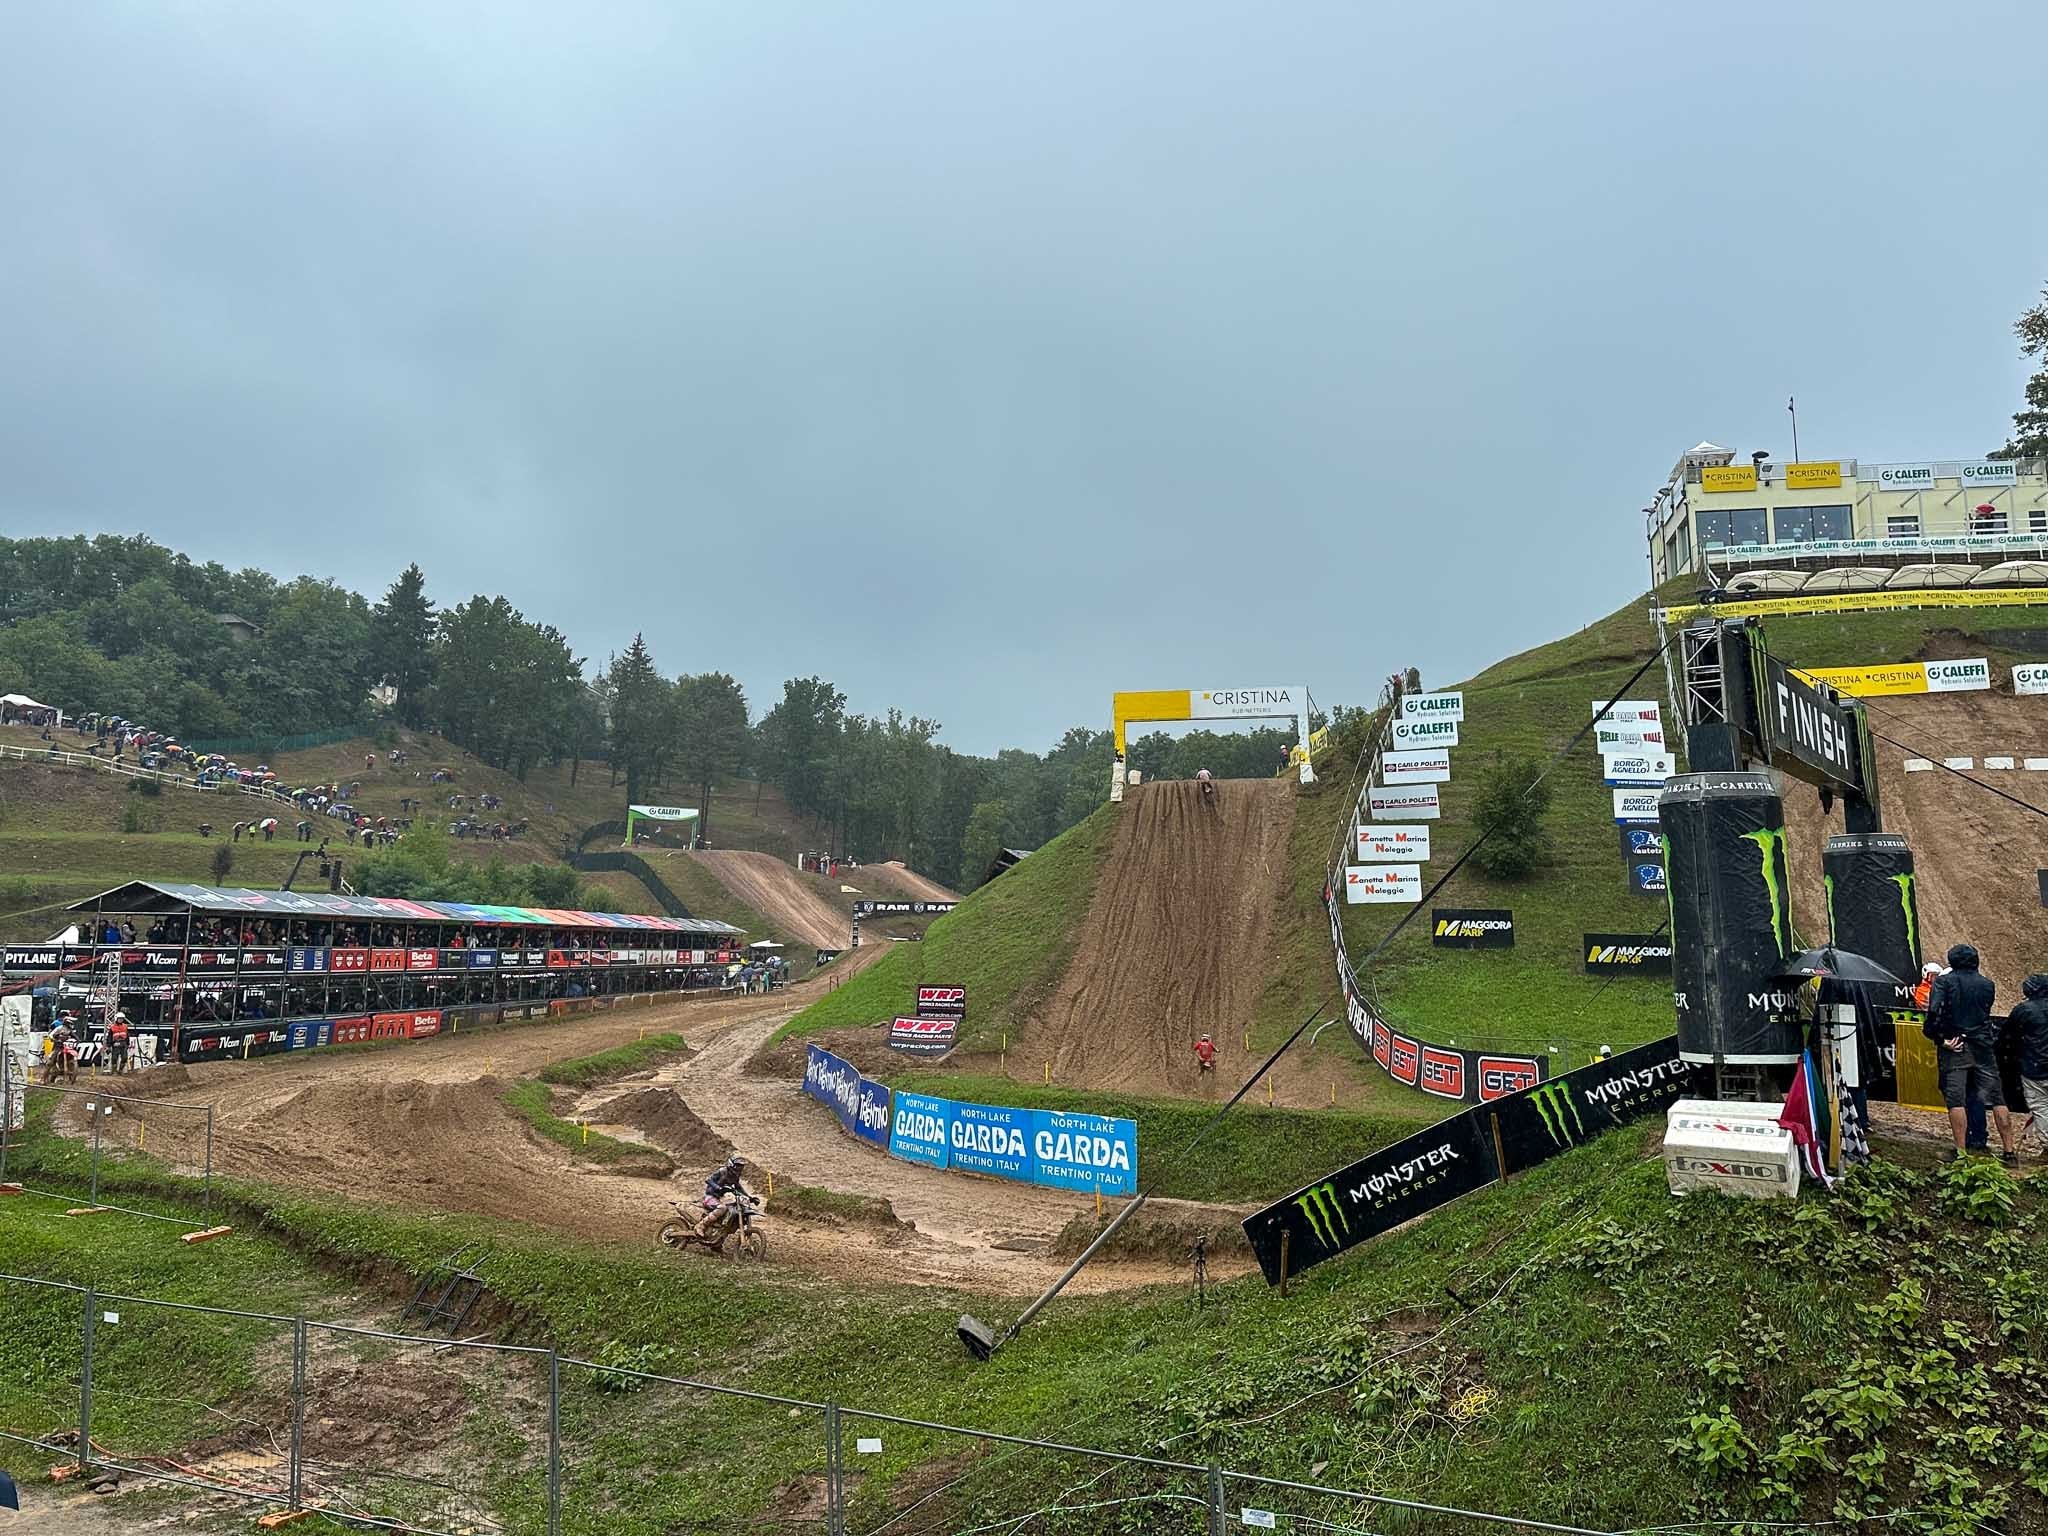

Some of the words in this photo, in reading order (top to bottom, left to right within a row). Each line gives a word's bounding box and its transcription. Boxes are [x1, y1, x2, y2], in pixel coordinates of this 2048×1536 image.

[1795, 469, 1837, 478] CRISTINA
[1895, 469, 1931, 480] CALEFFI
[1977, 465, 2014, 476] CALEFFI
[1710, 474, 1753, 482] CRISTINA
[2007, 535, 2034, 543] CALEFFI
[1872, 671, 1922, 682] CRISTINA
[1943, 664, 1986, 677] CALEFFI
[1213, 690, 1291, 705] CRISTINA
[1420, 698, 1460, 710] CALEFFI
[1638, 709, 1658, 721] VALLE
[1411, 722, 1454, 735] CALEFFI
[1777, 681, 1849, 770] FINISH
[1643, 732, 1662, 743] VALLE
[1408, 796, 1437, 804] POLETTI
[657, 808, 681, 816] CALEFFI
[1621, 804, 1657, 812] AGNELLO
[1359, 832, 1394, 842] Zanetta
[1395, 832, 1428, 842] Marino
[1375, 843, 1413, 854] Noleggio
[1348, 874, 1383, 884] Zanetta
[1385, 873, 1419, 883] Marino
[1365, 884, 1404, 895] Noleggio
[876, 903, 910, 911] RAM
[1461, 920, 1512, 930] MAGGIORA
[1459, 928, 1484, 937] PARK
[5, 953, 57, 964] PITLANE
[411, 952, 433, 960] Beta
[919, 987, 965, 1002] WRP
[414, 1016, 437, 1025] Beta
[893, 1018, 956, 1033] WRP
[1347, 994, 1373, 1047] ATHENA
[890, 1042, 946, 1050] wrpracing.com
[1393, 1047, 1415, 1073] GET
[1424, 1060, 1460, 1086] GET
[1484, 1069, 1534, 1093] GET
[1610, 1078, 1689, 1113] ENERGY
[905, 1097, 924, 1109] NORTH
[924, 1101, 939, 1113] LAKE
[960, 1108, 987, 1120] NORTH
[988, 1112, 1011, 1123] LAKE
[895, 1109, 946, 1145] GARDA
[1050, 1117, 1087, 1130] NORTH
[1090, 1121, 1115, 1134] LAKE
[951, 1120, 1027, 1158] GARDA
[896, 1139, 924, 1155] TRENTINO
[925, 1146, 941, 1159] ITALY
[1035, 1130, 1130, 1171] GARDA
[954, 1152, 993, 1168] TRENTINO
[996, 1159, 1020, 1171] ITALY
[1040, 1164, 1093, 1181] TRENTINO
[1096, 1172, 1123, 1185] ITALY
[1349, 1143, 1460, 1204] MONSTER
[1374, 1169, 1448, 1209] ENERGY
